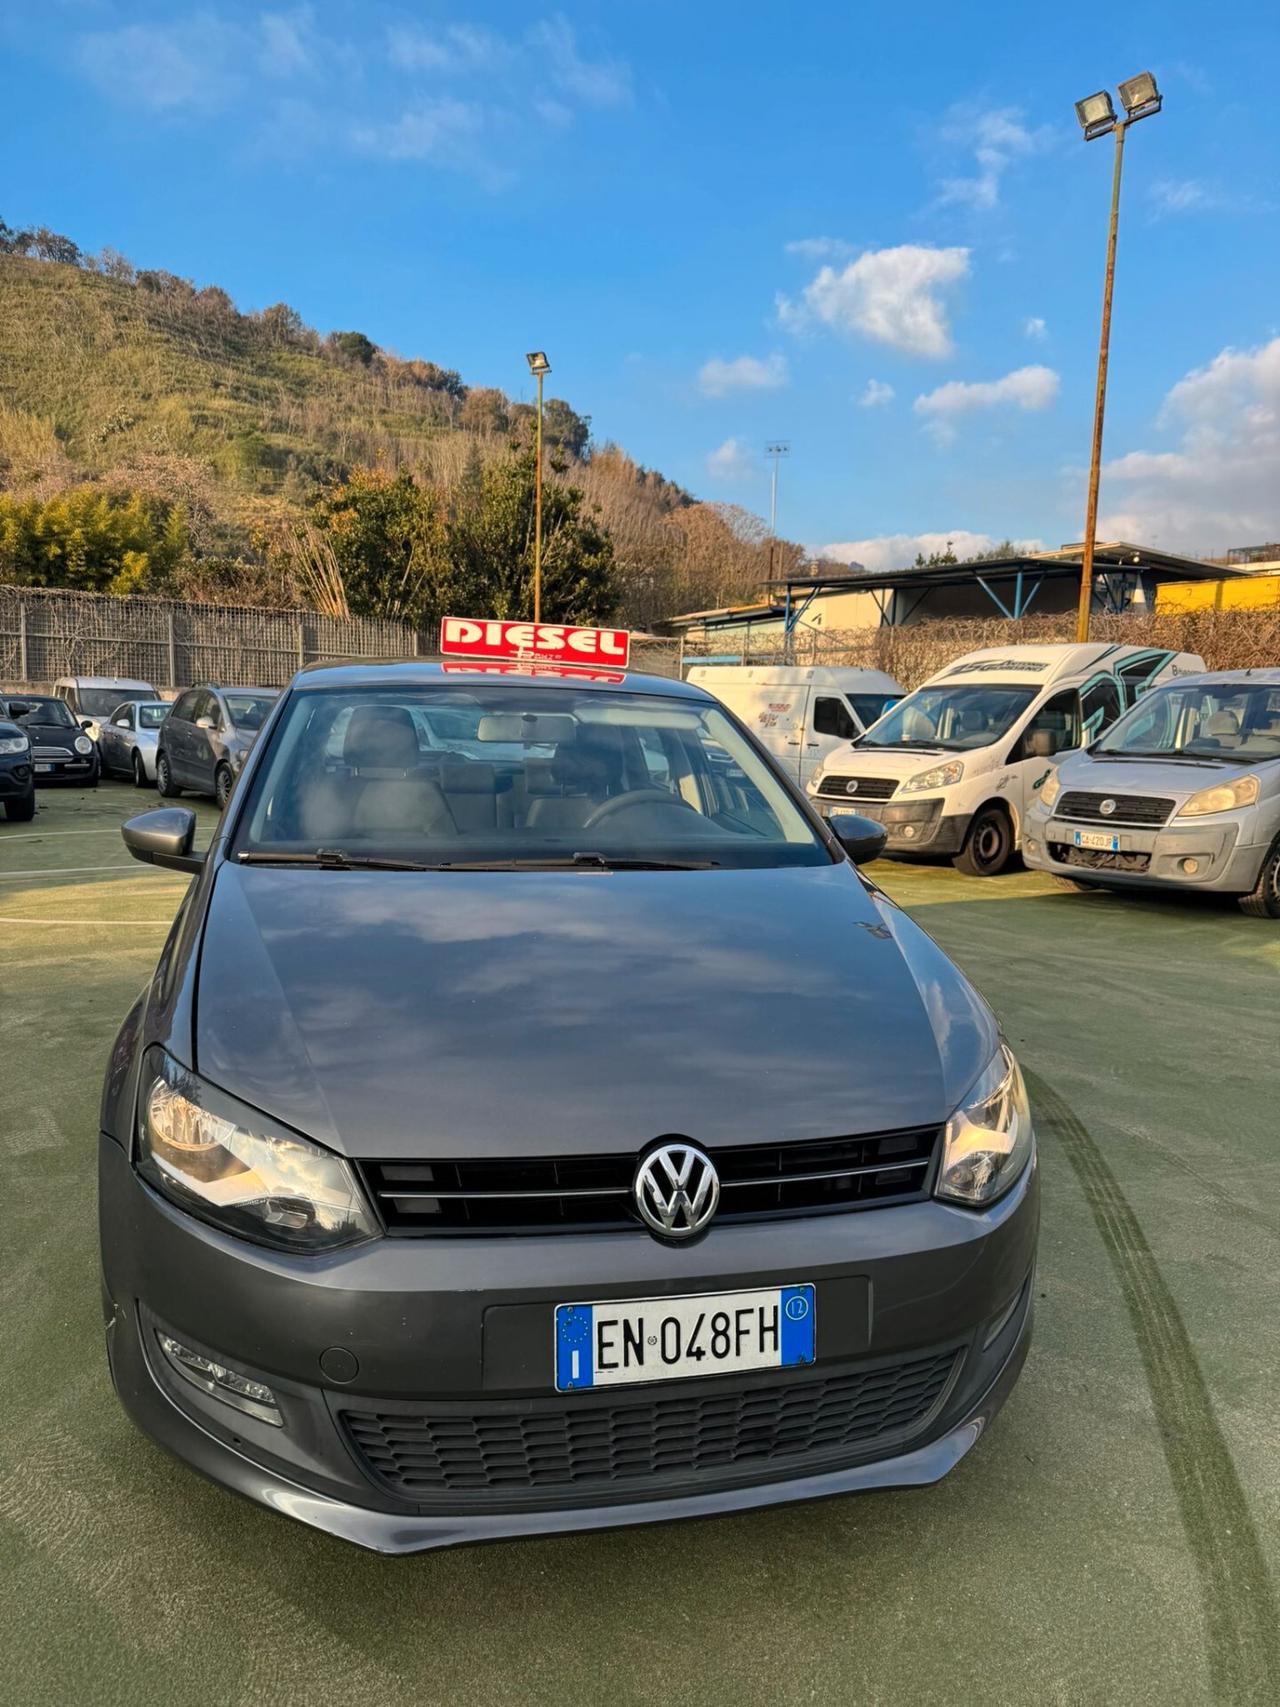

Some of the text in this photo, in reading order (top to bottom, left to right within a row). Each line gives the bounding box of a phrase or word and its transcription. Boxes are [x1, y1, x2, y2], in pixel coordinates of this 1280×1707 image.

[445, 620, 625, 656] DIESEL
[790, 1300, 804, 1316] 12
[597, 1304, 779, 1370] EN 048FH
